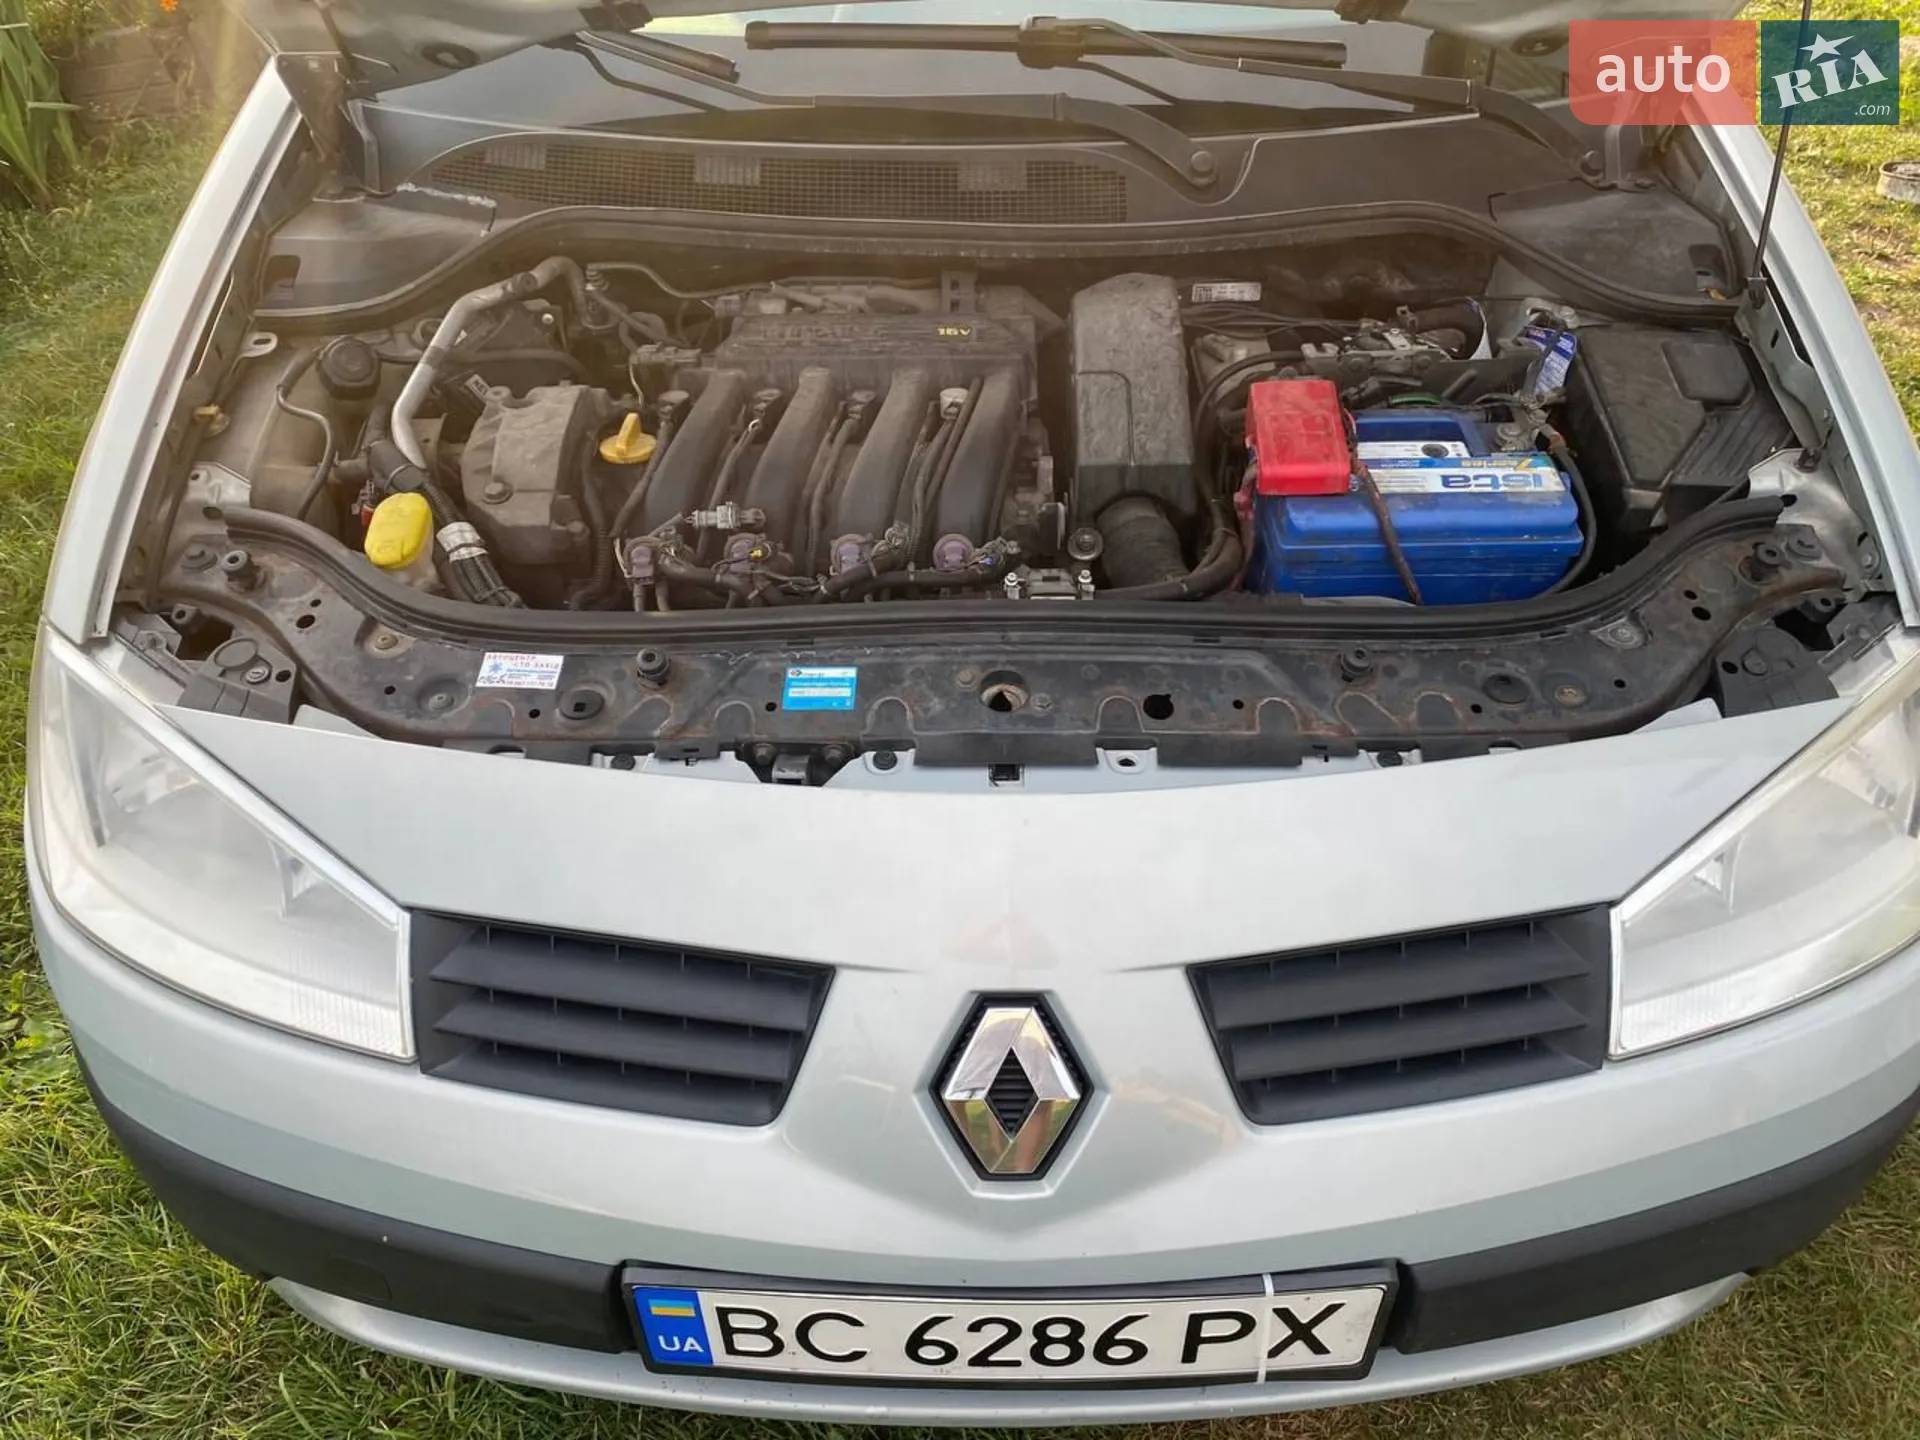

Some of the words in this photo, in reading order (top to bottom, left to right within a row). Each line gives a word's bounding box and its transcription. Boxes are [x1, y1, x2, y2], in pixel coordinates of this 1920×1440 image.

[1440, 473, 1543, 490] ista
[658, 1335, 704, 1353] UA
[715, 1306, 869, 1363] BC
[905, 1313, 1149, 1368] 6286
[1181, 1302, 1346, 1365] PX
